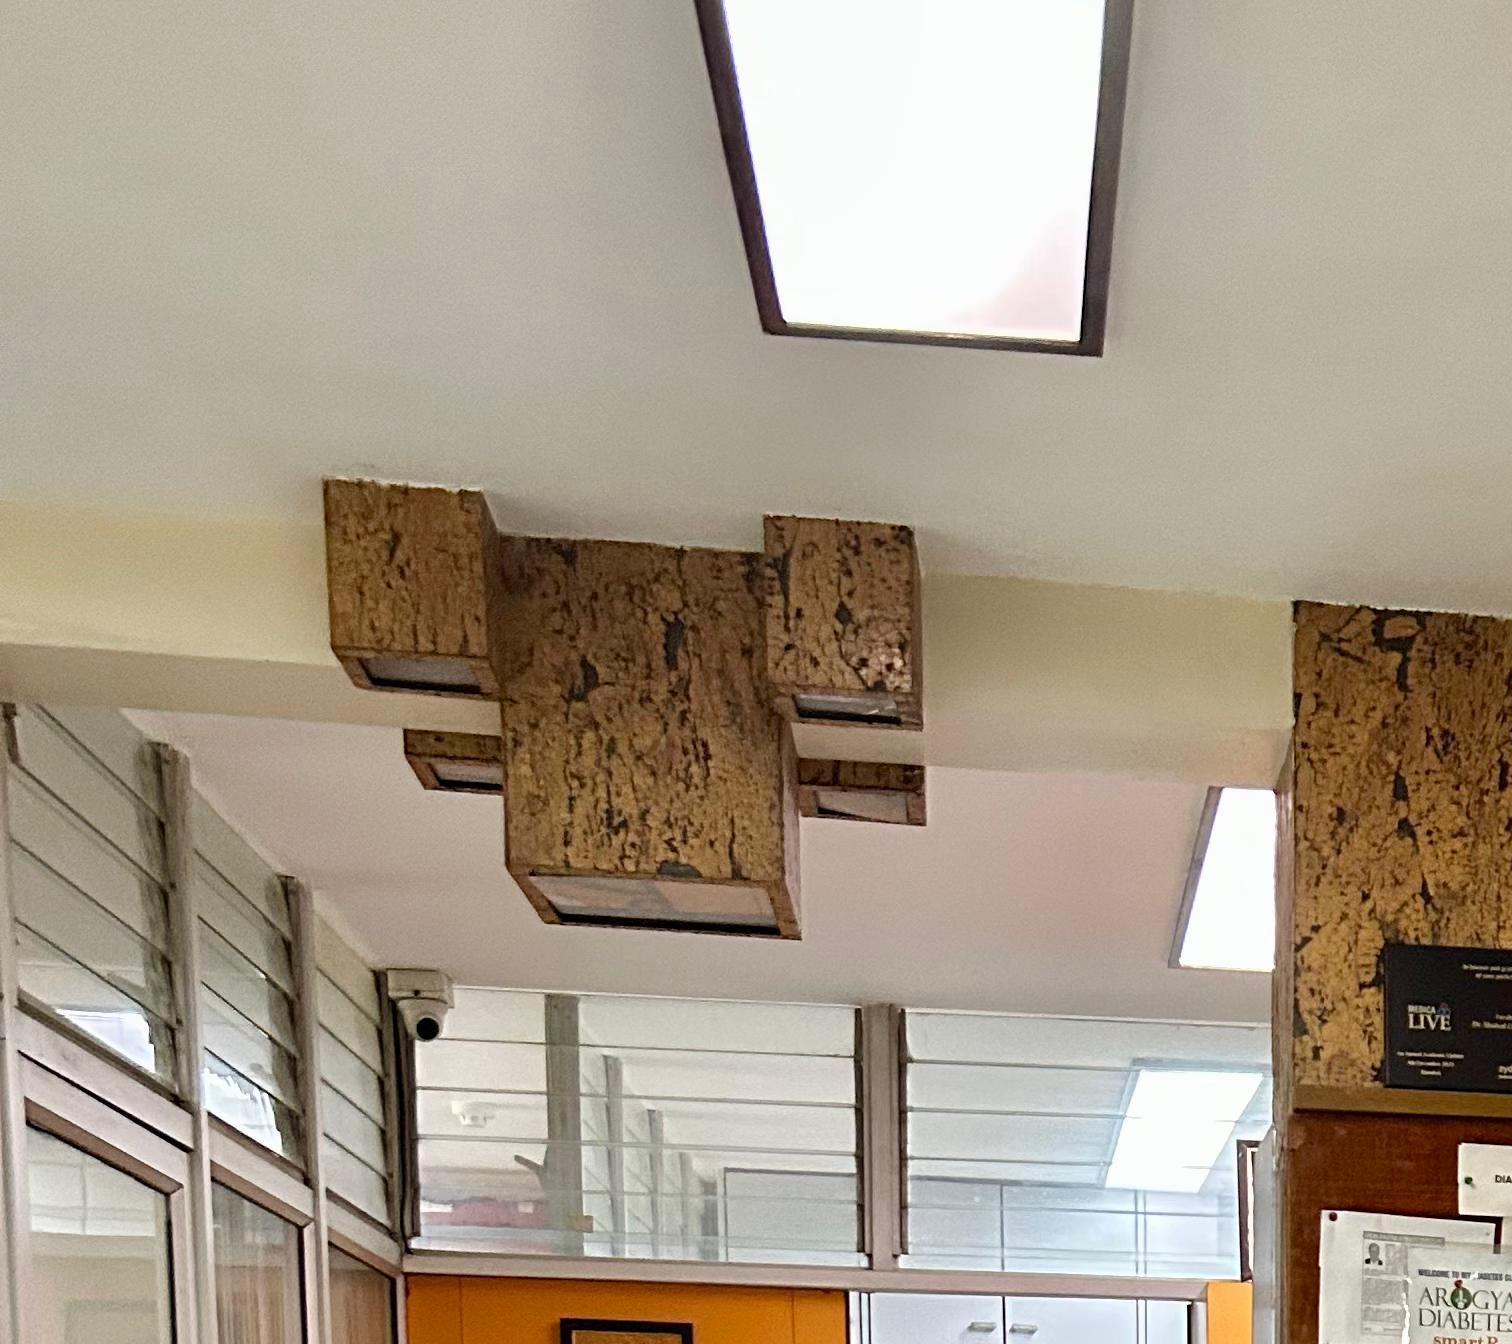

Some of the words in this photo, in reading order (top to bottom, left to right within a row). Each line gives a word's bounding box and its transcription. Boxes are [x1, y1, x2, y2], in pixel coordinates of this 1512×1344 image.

[1409, 1014, 1452, 1031] LIVE
[1418, 1269, 1450, 1278] WELCOME
[1452, 1270, 1459, 1278] TO
[1472, 1272, 1503, 1281] IABETES
